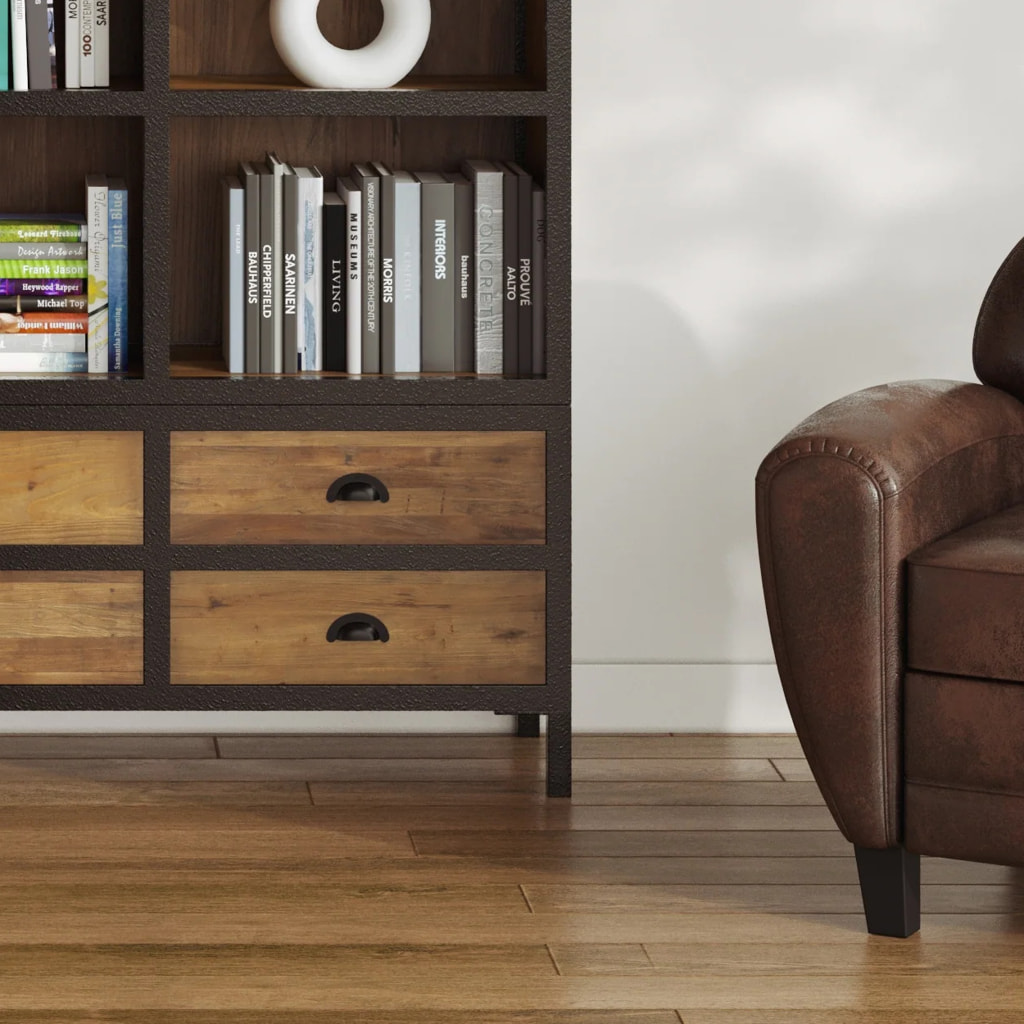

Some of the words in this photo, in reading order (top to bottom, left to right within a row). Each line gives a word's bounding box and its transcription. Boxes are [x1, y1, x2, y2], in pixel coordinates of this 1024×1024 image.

[94, 191, 106, 227] Flower
[110, 192, 123, 220] Blue
[367, 182, 375, 212] VISIONARY
[112, 224, 127, 249] Just
[350, 213, 358, 280] MUSEUMS
[367, 212, 375, 258] ARCHITECTURE
[434, 219, 446, 280] INTERIORS
[17, 246, 45, 258] Design
[47, 246, 83, 256] Artwork
[367, 259, 375, 268] OF
[479, 205, 494, 331] CONCRETE
[22, 265, 51, 274] Frank
[54, 265, 84, 274] Jason
[248, 251, 258, 304] BAUHAUS
[262, 244, 272, 318] CHIPPERFIELD
[284, 253, 296, 315] SAARINEN
[331, 259, 341, 313] LIVING
[367, 268, 375, 281] THE
[383, 258, 393, 304] MORRIS
[461, 255, 469, 299] bauhaus
[506, 266, 516, 301] AALTO
[519, 258, 532, 306] PROUVÉ
[22, 283, 54, 292] Heywood
[37, 299, 68, 308] Michael
[69, 299, 85, 309] Top
[367, 282, 375, 301] 20TH
[113, 307, 122, 337] Downing
[367, 301, 375, 333] CENTURY
[112, 338, 121, 370] Samantha
